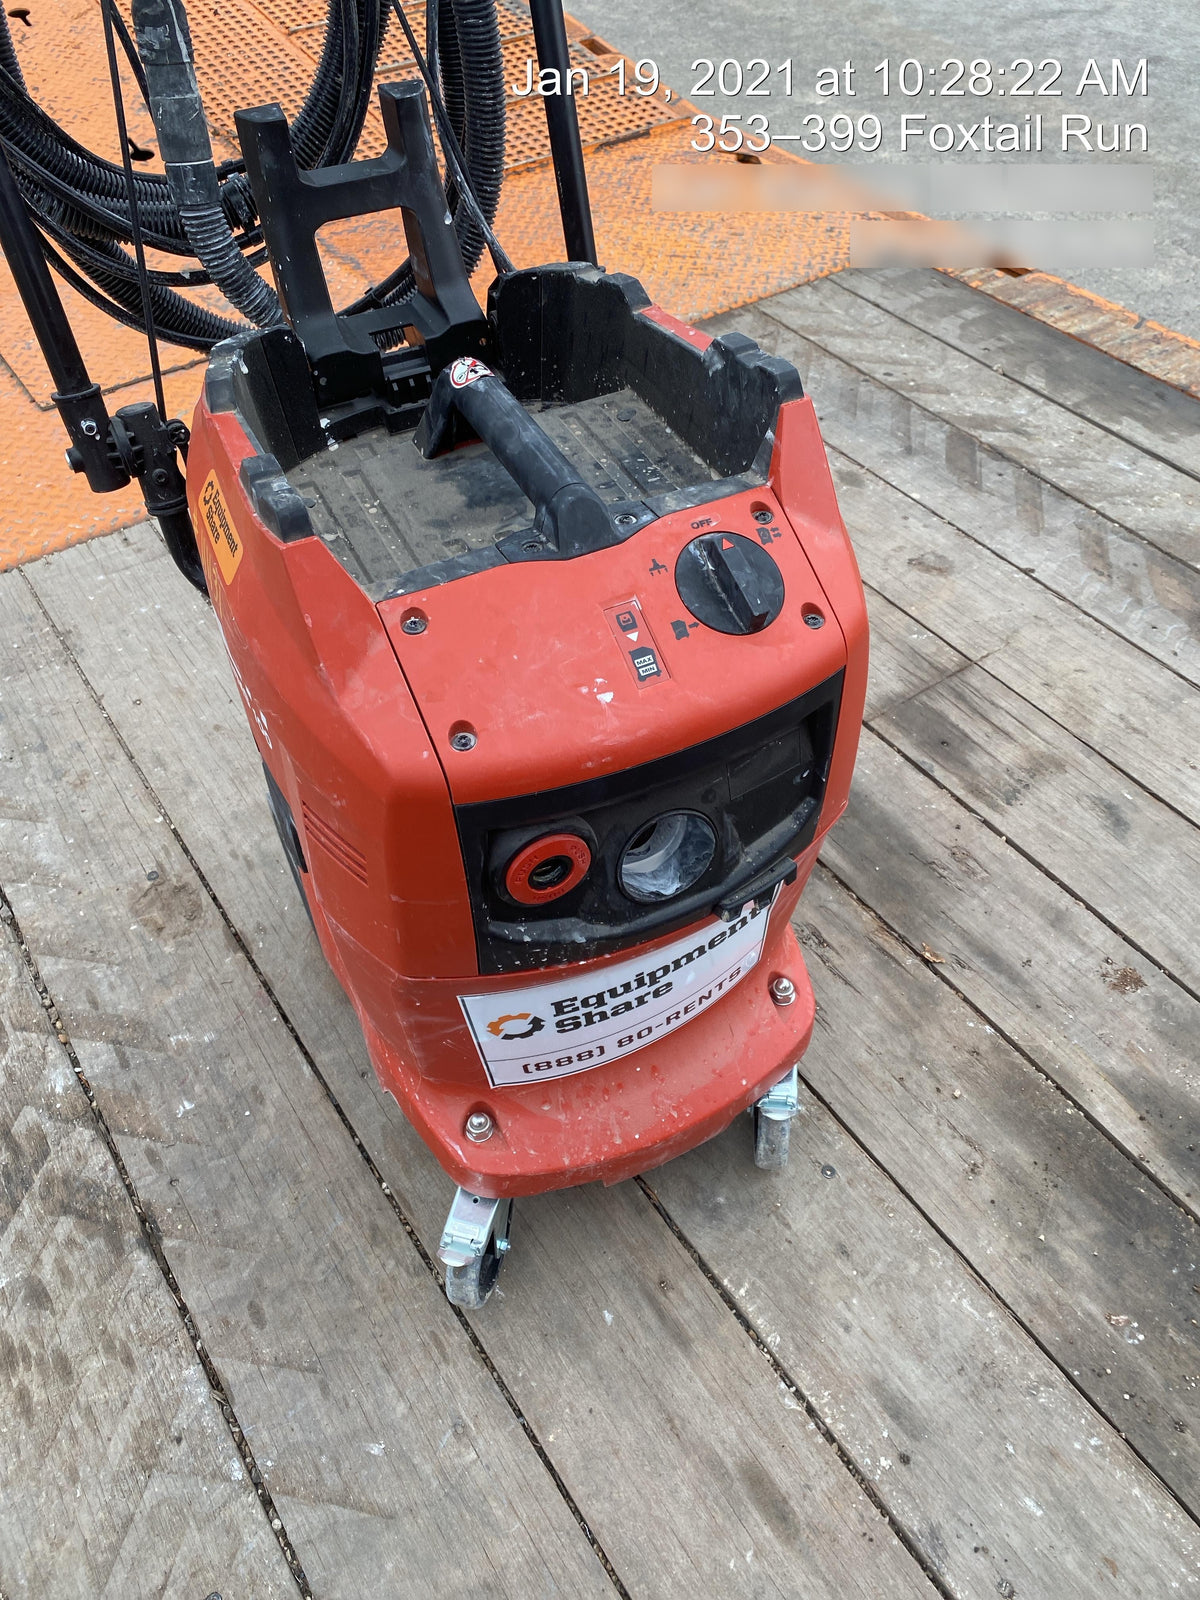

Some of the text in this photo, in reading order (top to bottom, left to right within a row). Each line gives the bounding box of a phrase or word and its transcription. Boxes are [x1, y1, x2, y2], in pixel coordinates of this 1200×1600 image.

[205, 504, 220, 544] Share
[214, 488, 239, 558] Equipment
[690, 518, 713, 530] OFF
[636, 655, 653, 667] MAX
[641, 665, 655, 676] MIN
[550, 903, 762, 1018] Equipment
[554, 981, 674, 1034] Share
[616, 966, 742, 1049] 80-RENTS
